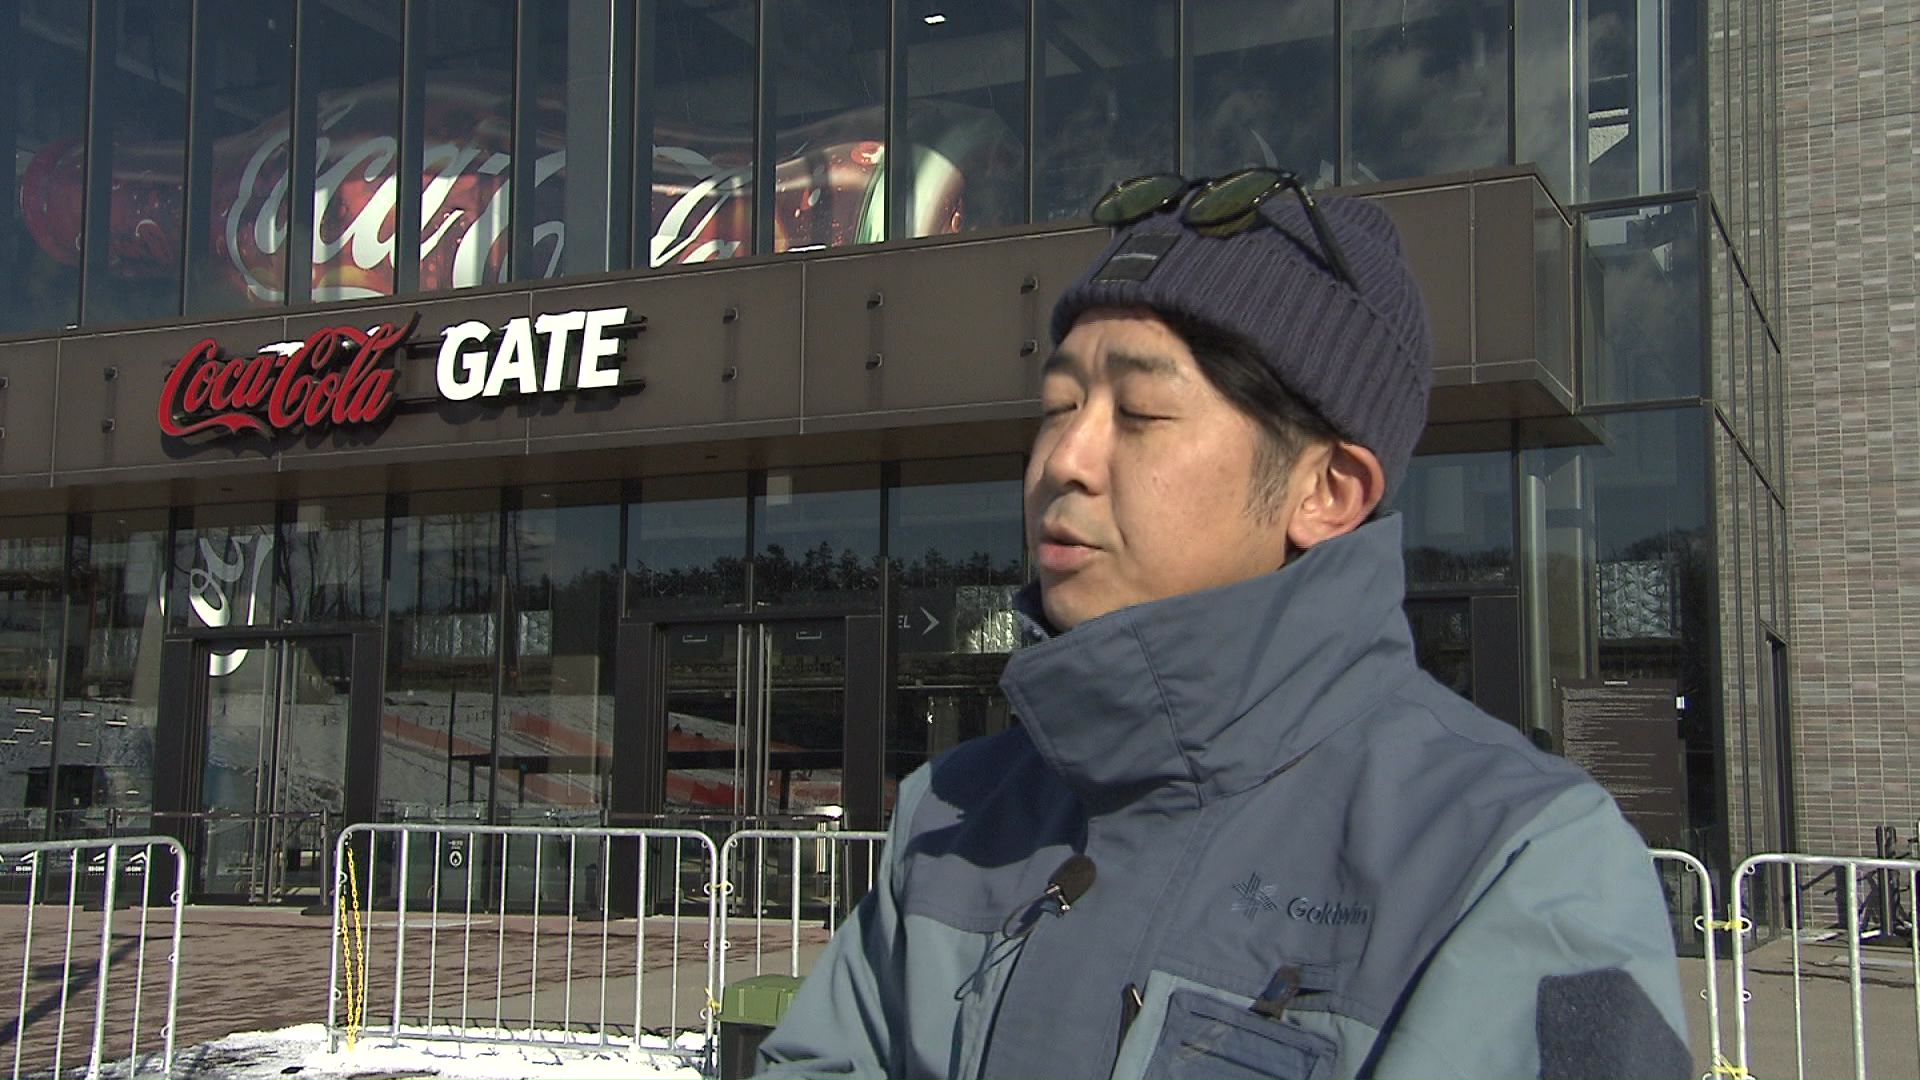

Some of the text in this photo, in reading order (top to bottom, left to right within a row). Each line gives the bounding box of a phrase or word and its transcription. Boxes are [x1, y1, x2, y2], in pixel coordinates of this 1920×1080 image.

[225, 110, 742, 301] Coca-Cl
[156, 306, 629, 437] Coca-Cola GATE
[1287, 896, 1369, 926] Goldwin
